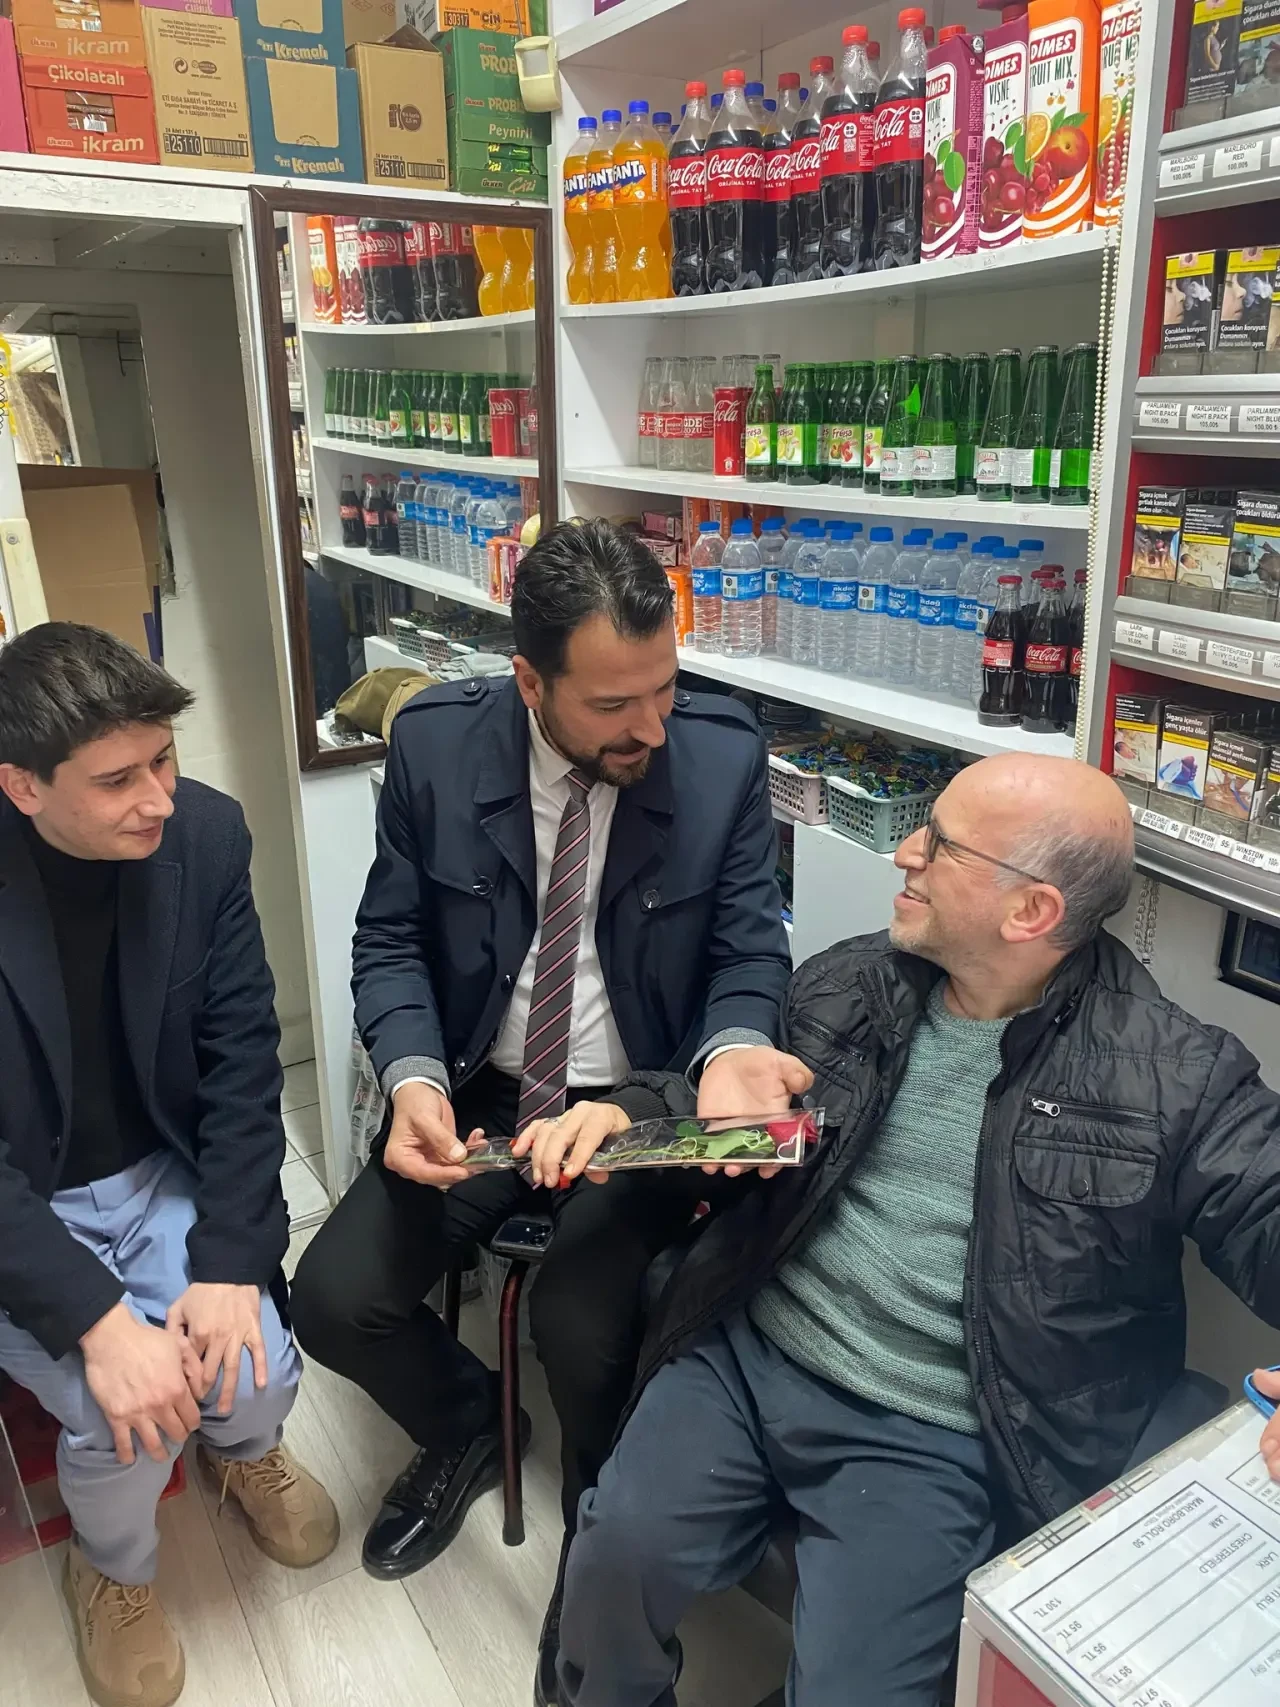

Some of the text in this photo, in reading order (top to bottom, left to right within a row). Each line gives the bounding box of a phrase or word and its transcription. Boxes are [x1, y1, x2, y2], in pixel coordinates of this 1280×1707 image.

[67, 37, 129, 56] ikram
[1031, 33, 1074, 60] DİMES
[480, 54, 518, 74] PROB
[985, 55, 1019, 80] DİMES
[1030, 55, 1073, 90] FRUIT MIX
[48, 64, 125, 87] Çikolatalı
[488, 97, 520, 112] PROB
[489, 123, 533, 140] Peynirli
[82, 135, 144, 154] ikram
[170, 135, 201, 154] 25110
[707, 152, 764, 181] Coca-Cola
[1232, 153, 1245, 161] RED
[588, 168, 613, 189] FANT
[613, 160, 647, 182] FANTA
[1237, 499, 1255, 509] Sigara
[1261, 511, 1280, 519] öldürü
[1026, 645, 1062, 662] Coca-Cola
[1164, 721, 1178, 731] genç
[1165, 712, 1183, 723] Sigara
[1213, 737, 1229, 749] Sigara
[1189, 829, 1216, 843] WINSTON
[1236, 844, 1265, 860] WINSTON
[1162, 1496, 1205, 1528] MARLBORO
[1208, 1514, 1229, 1529] L&M
[1141, 1522, 1165, 1539] ROLL
[1132, 1538, 1145, 1549] 50
[1198, 1532, 1253, 1574] CHESTERFIELD
[1255, 1551, 1279, 1570] LARK
[1033, 1597, 1062, 1618] 130 TL
[1057, 1620, 1083, 1639] 95 TL
[1081, 1642, 1107, 1662] 95 TL
[1107, 1665, 1133, 1685] 95 TL
[1145, 1688, 1159, 1701] 97
